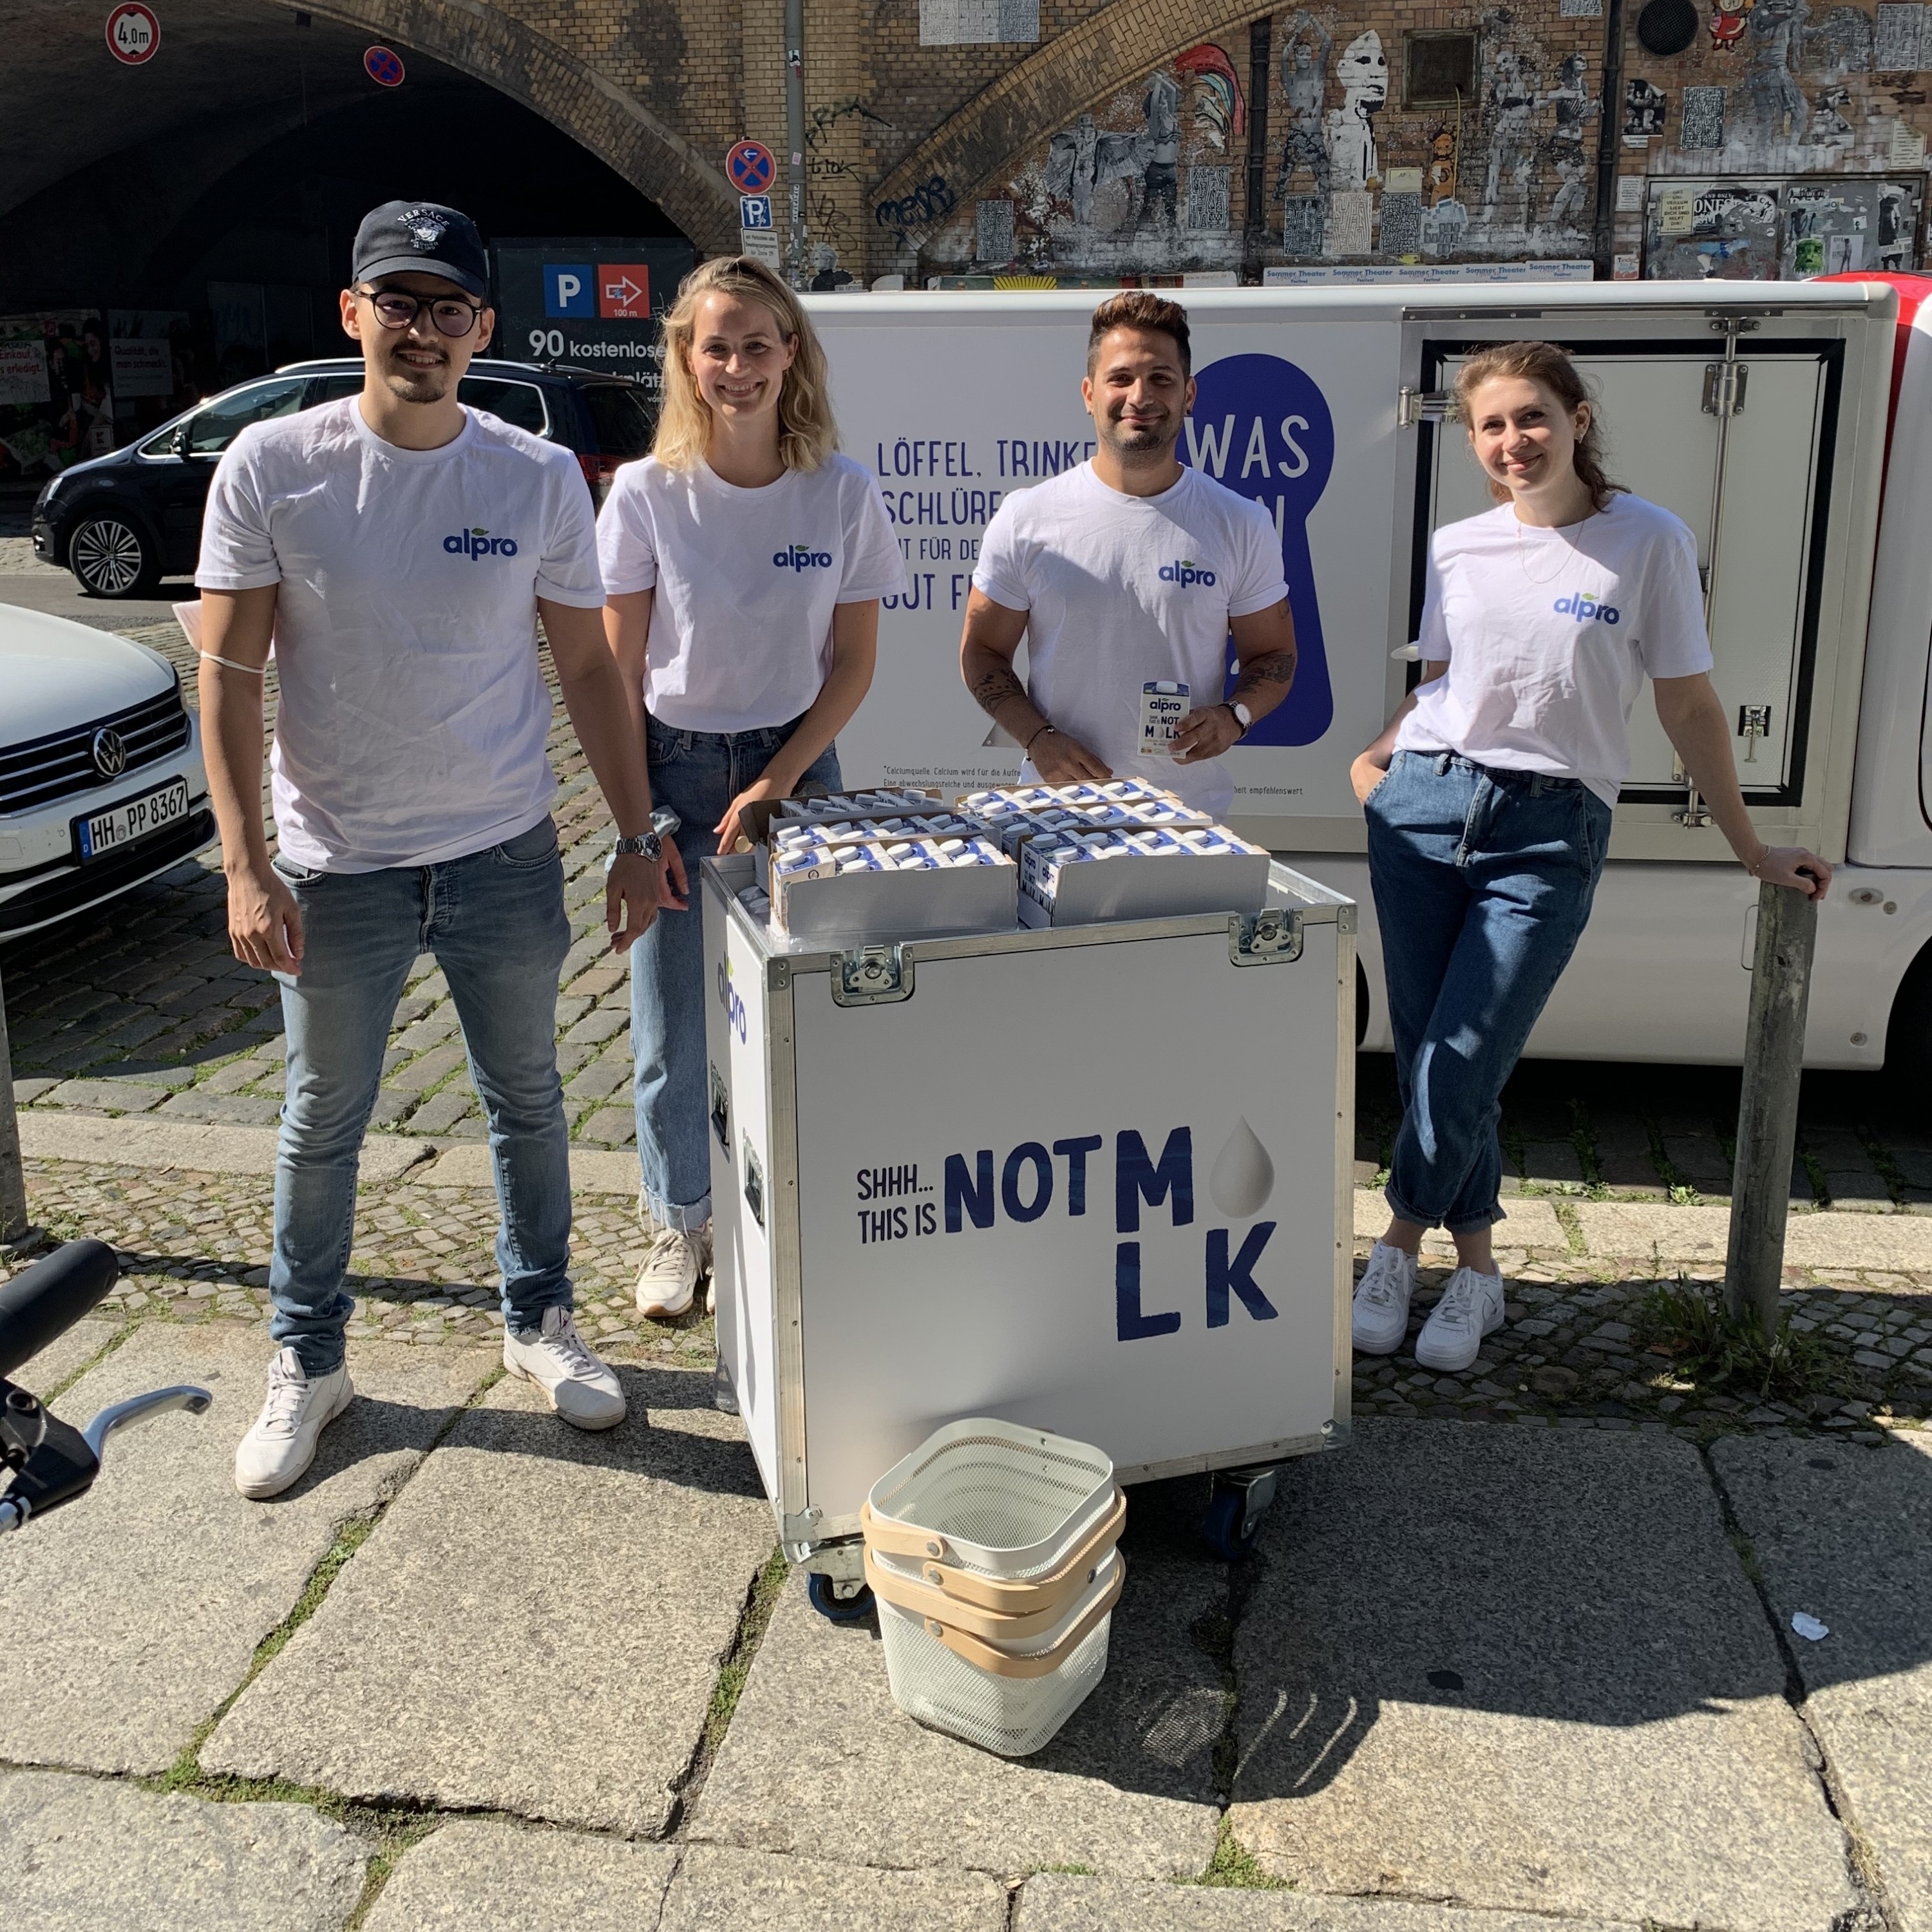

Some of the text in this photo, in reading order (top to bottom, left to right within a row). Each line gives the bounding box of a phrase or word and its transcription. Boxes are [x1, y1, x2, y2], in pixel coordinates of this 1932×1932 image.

[397, 209, 450, 227] VERSACE
[748, 200, 764, 225] P
[558, 274, 581, 308] P
[613, 309, 628, 317] 100
[529, 329, 666, 357] 90 kostenlose
[878, 437, 982, 478] LÖFFEL,
[1184, 414, 1310, 478] WAS
[443, 528, 518, 562] alpro
[773, 545, 832, 573] alpro
[920, 536, 951, 560] FÜR
[960, 539, 983, 560] DE
[1159, 560, 1216, 589] alpro
[1553, 592, 1620, 625] alpro
[1150, 698, 1182, 713] alpro
[1160, 715, 1180, 725] NOT
[884, 779, 896, 787] Eine
[963, 780, 974, 788] und
[934, 767, 959, 775] Calcium
[961, 768, 975, 776] wird
[978, 768, 989, 776] für
[1249, 786, 1303, 795] empfehlenswert
[91, 785, 185, 850] HH PP 8367
[717, 949, 747, 1046] alpro
[857, 1163, 934, 1200] SHHH...
[857, 1206, 908, 1244] THIS
[914, 1202, 936, 1236] IS
[944, 1134, 1102, 1234] NOT
